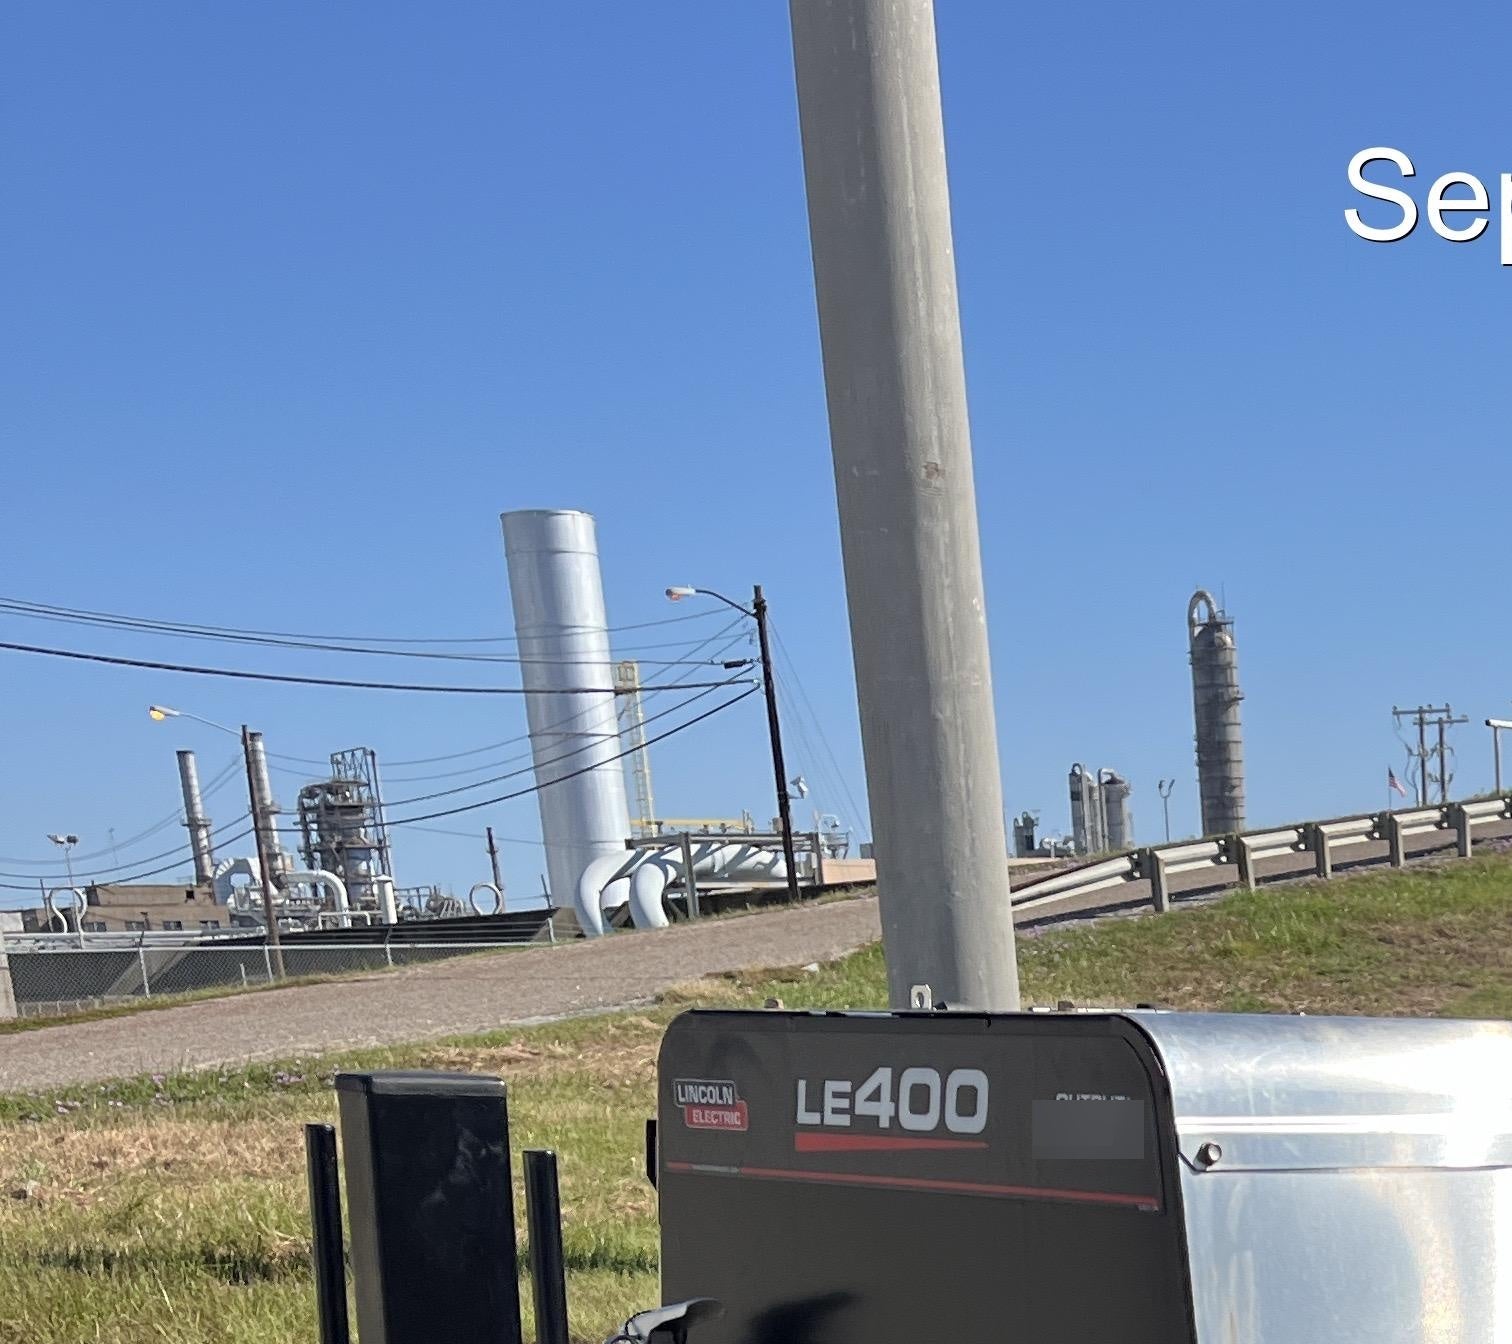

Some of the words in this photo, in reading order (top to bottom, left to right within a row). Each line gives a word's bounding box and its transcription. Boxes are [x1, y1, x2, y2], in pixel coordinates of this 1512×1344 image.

[677, 1085, 733, 1105] LINCOLN
[797, 1067, 989, 1133] LE400
[692, 1110, 741, 1126] ELECTRIC
